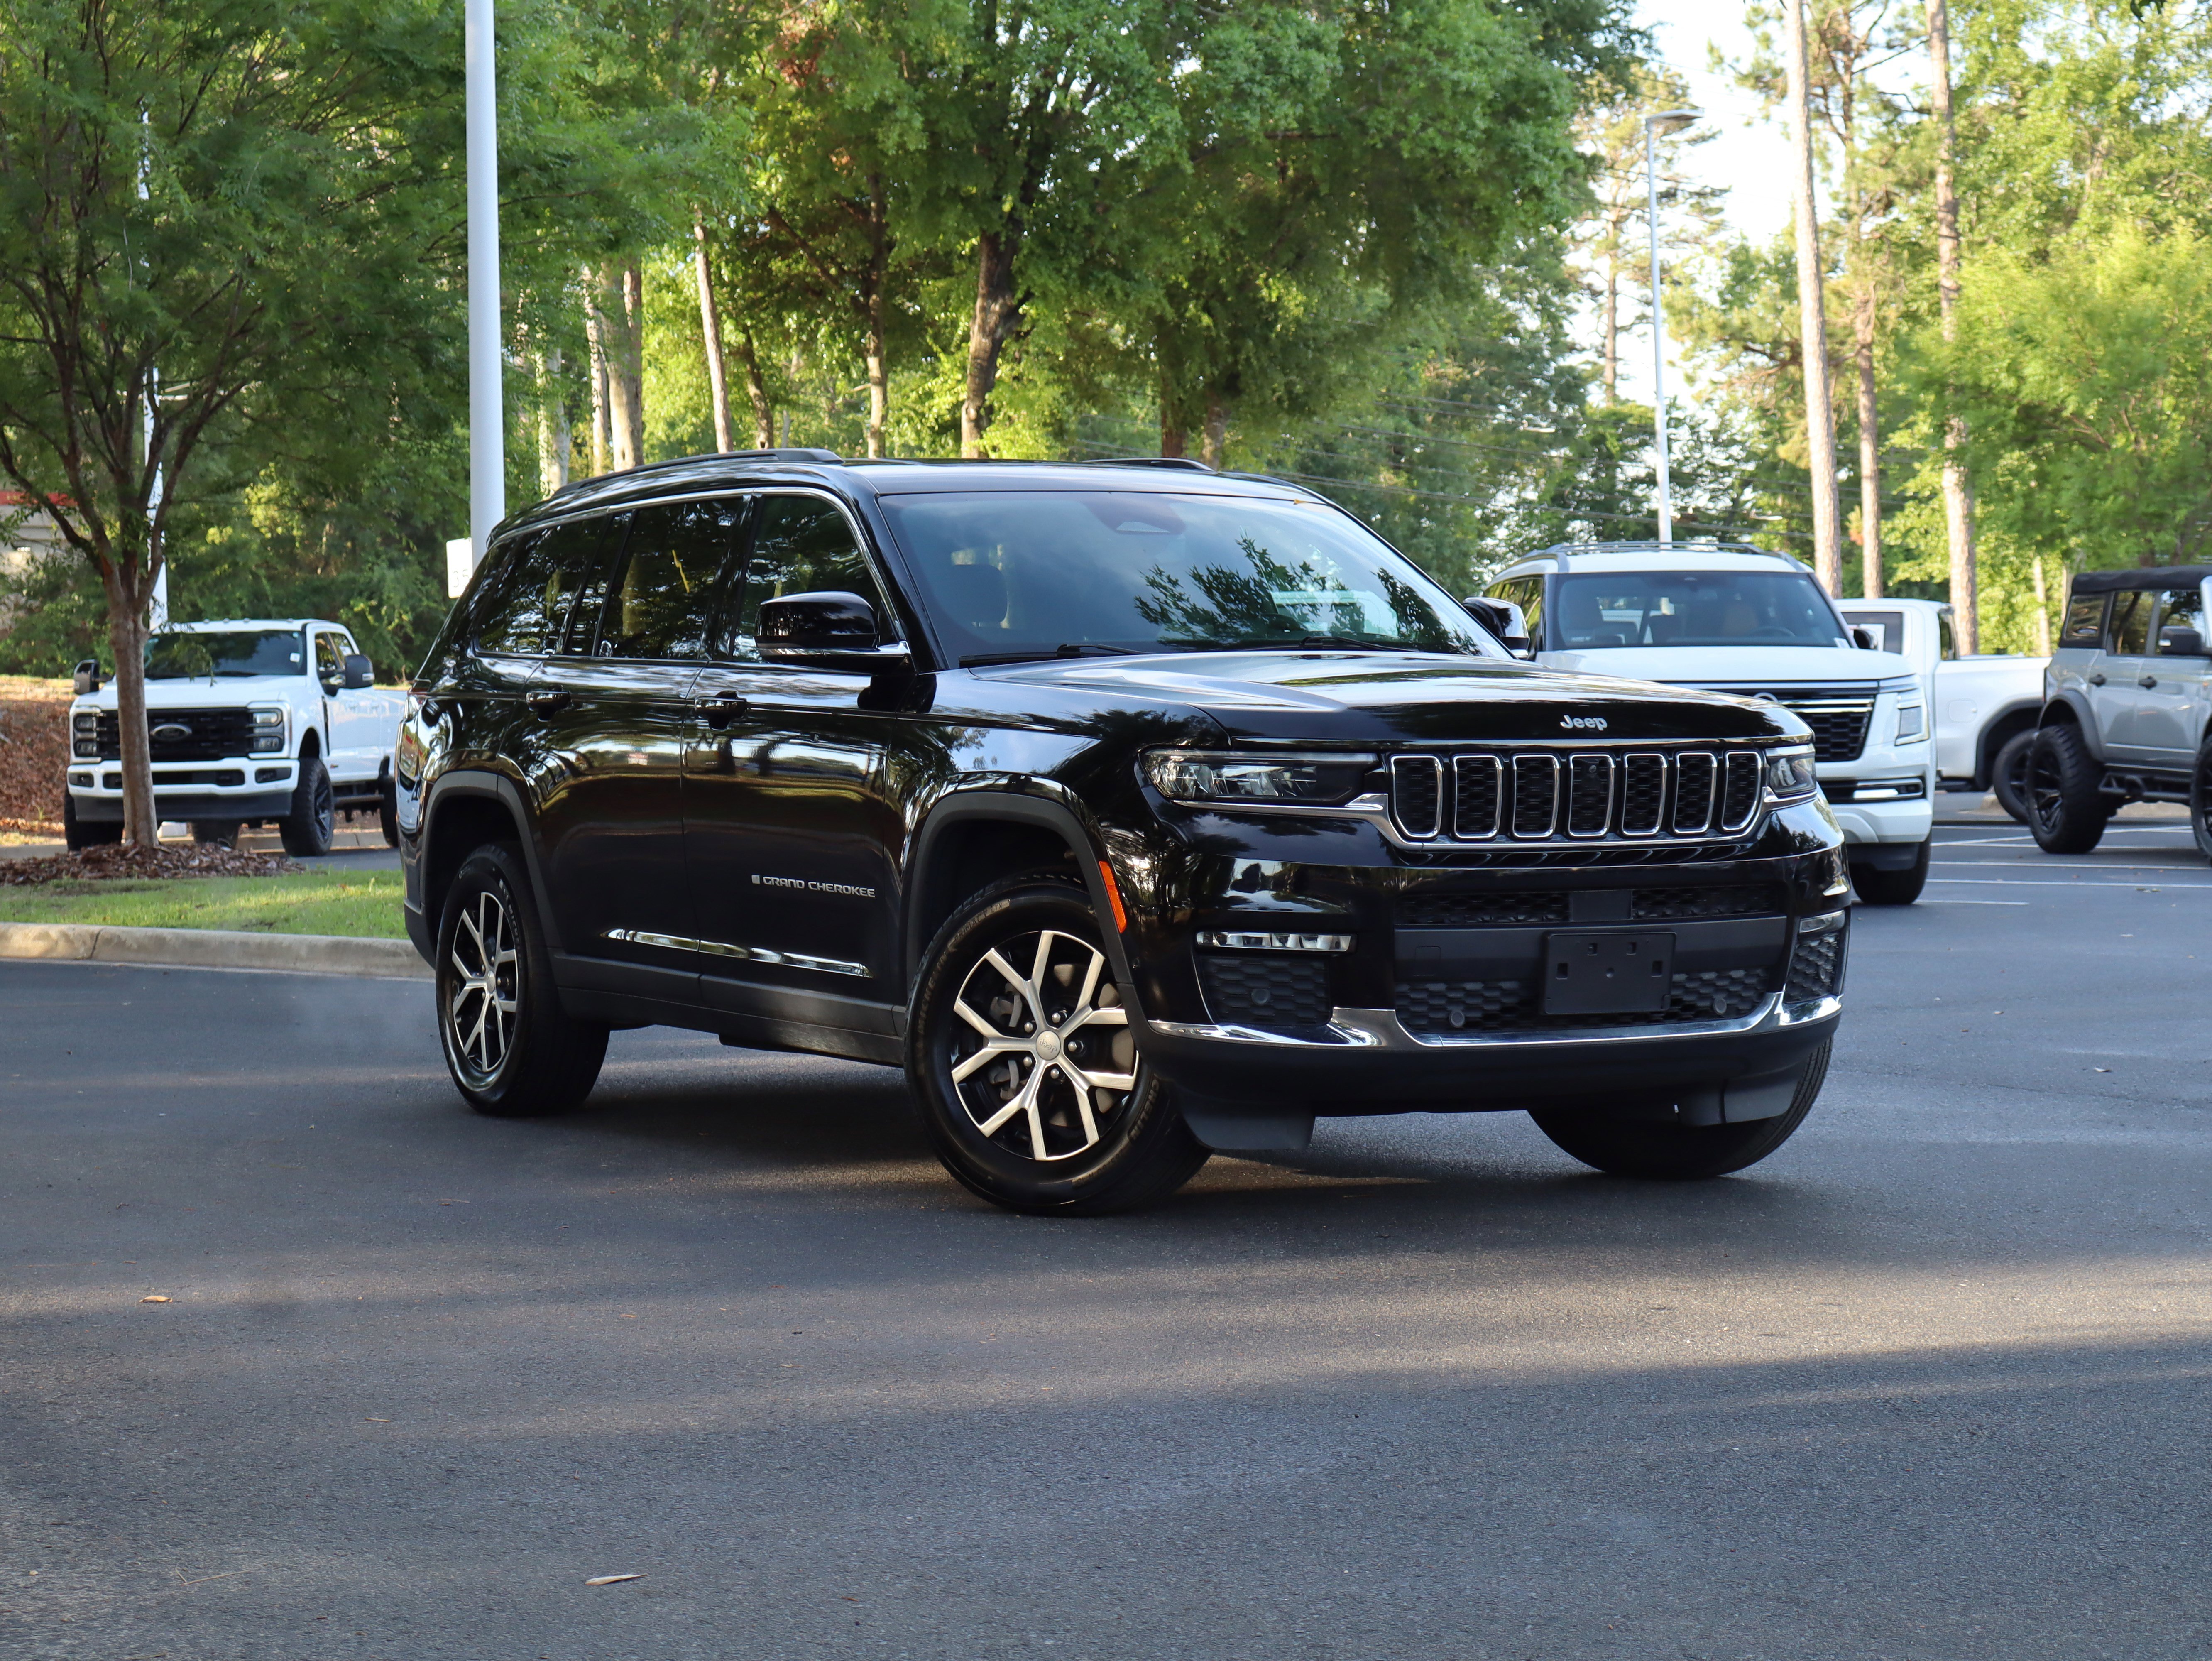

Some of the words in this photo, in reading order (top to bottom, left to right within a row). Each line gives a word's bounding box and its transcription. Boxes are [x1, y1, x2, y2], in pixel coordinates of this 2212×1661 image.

[453, 569, 470, 588] 35
[1560, 714, 1608, 731] Jeep
[763, 876, 805, 889] GRAND
[808, 881, 876, 898] CHEROKEE
[990, 903, 1002, 913] LTX
[918, 951, 947, 1034] MICHEIN
[1039, 1039, 1057, 1053] Jeep
[1130, 1079, 1160, 1141] CHELIN
